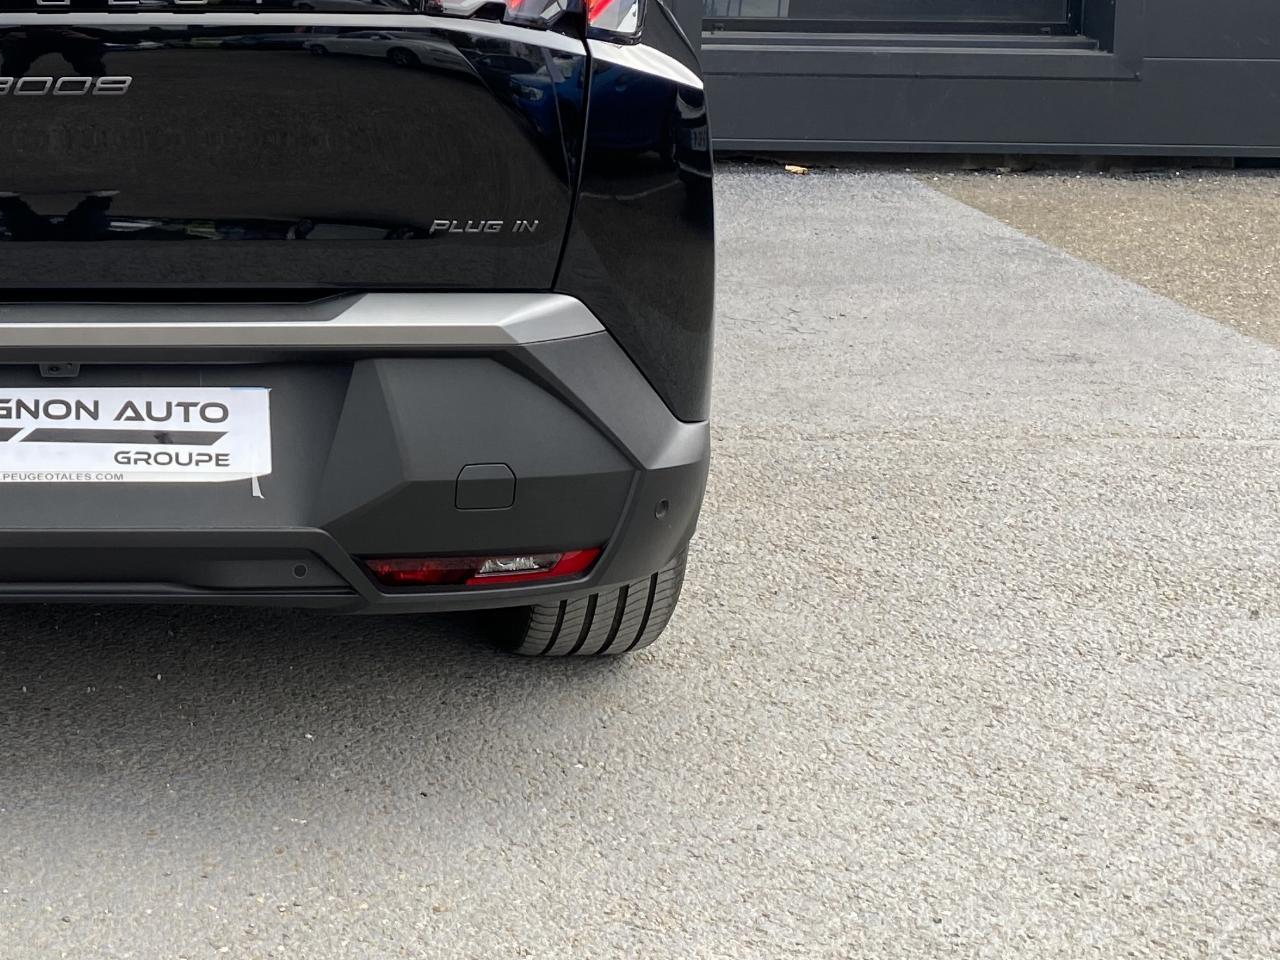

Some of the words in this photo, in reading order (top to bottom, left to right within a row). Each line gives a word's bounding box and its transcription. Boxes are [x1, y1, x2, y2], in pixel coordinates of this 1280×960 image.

[429, 220, 503, 233] PLUG
[512, 220, 539, 232] IN
[112, 398, 230, 424] AUTO
[113, 450, 231, 467] GROUPE
